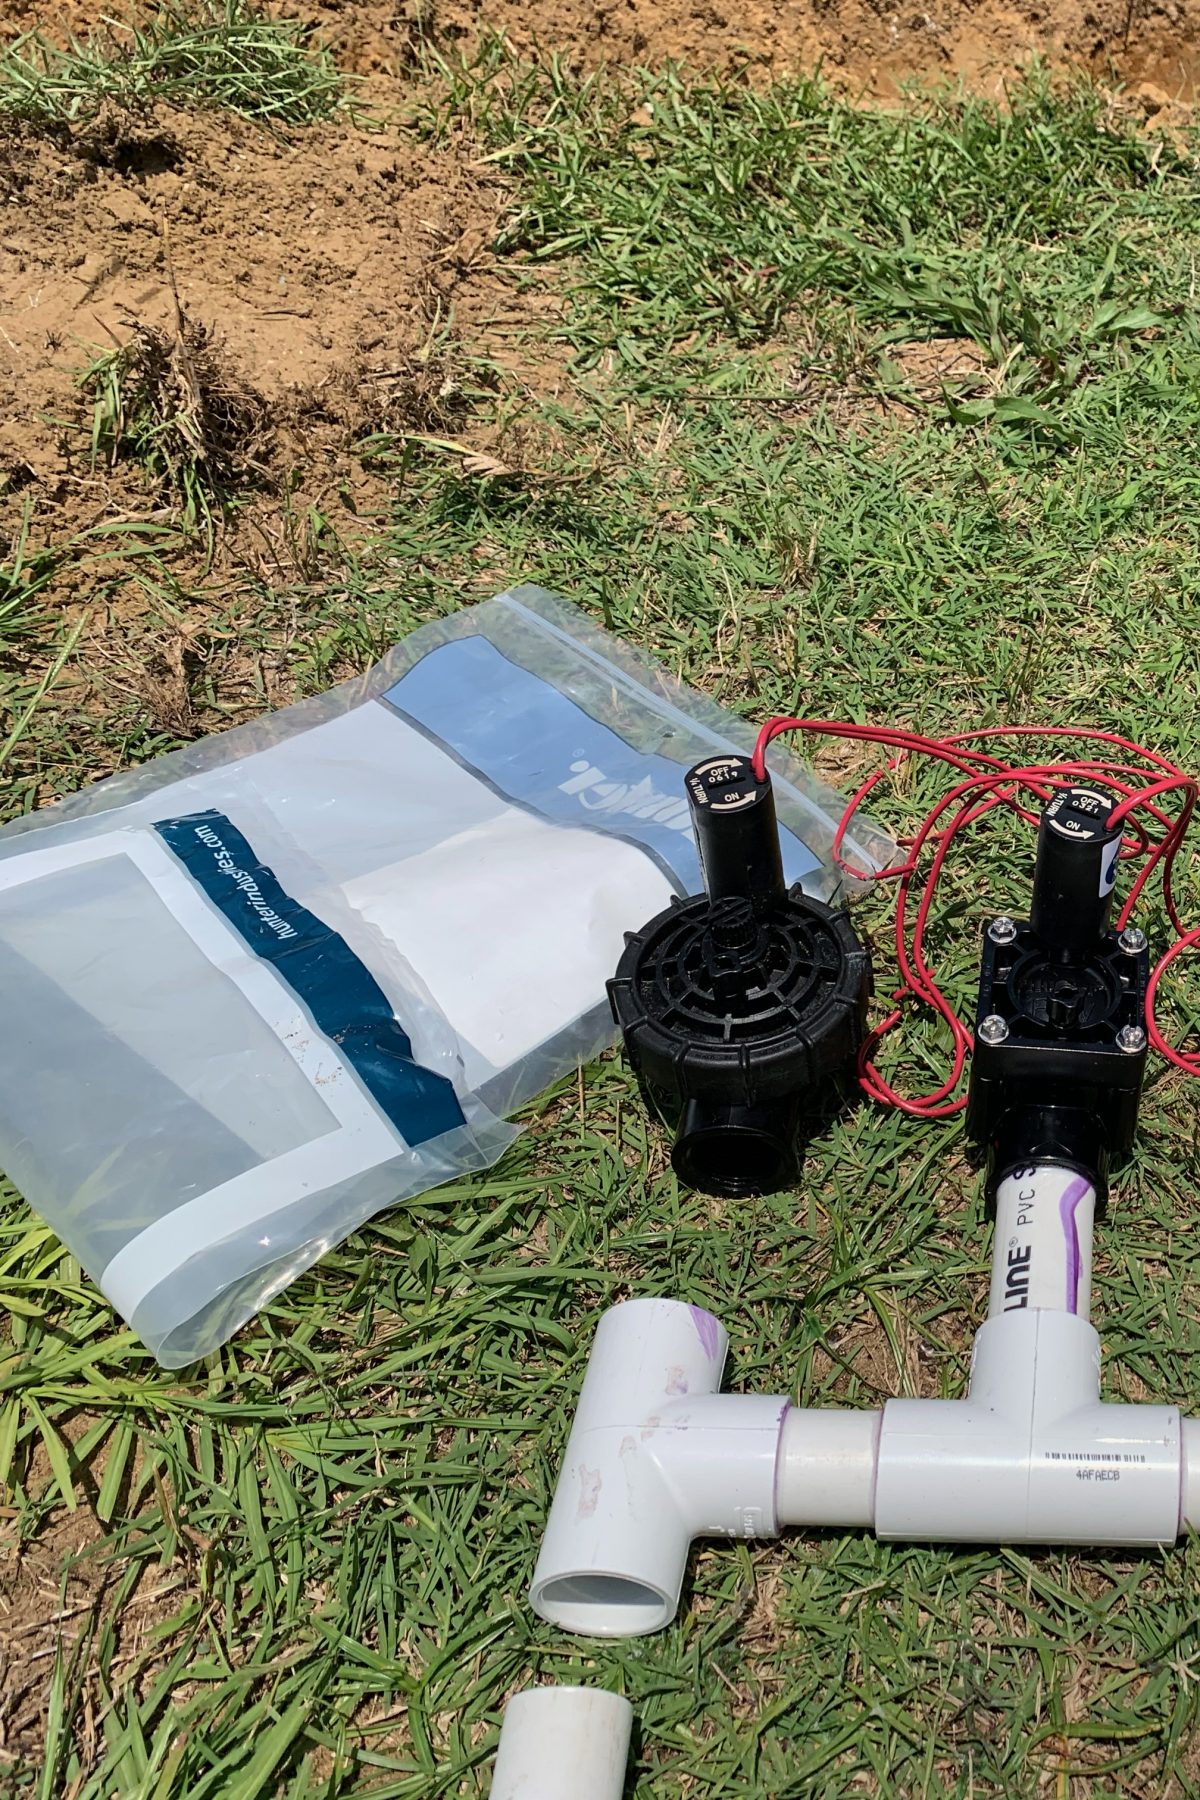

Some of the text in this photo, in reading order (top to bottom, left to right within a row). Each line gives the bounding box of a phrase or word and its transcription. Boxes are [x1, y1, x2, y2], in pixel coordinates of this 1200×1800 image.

[711, 766, 729, 777] OFF
[692, 784, 709, 804] TURN
[724, 791, 740, 802] ON
[1080, 796, 1099, 807] OFF
[1045, 798, 1065, 817] TURN
[1065, 820, 1081, 831] ON
[1017, 1188, 1036, 1227] PVC
